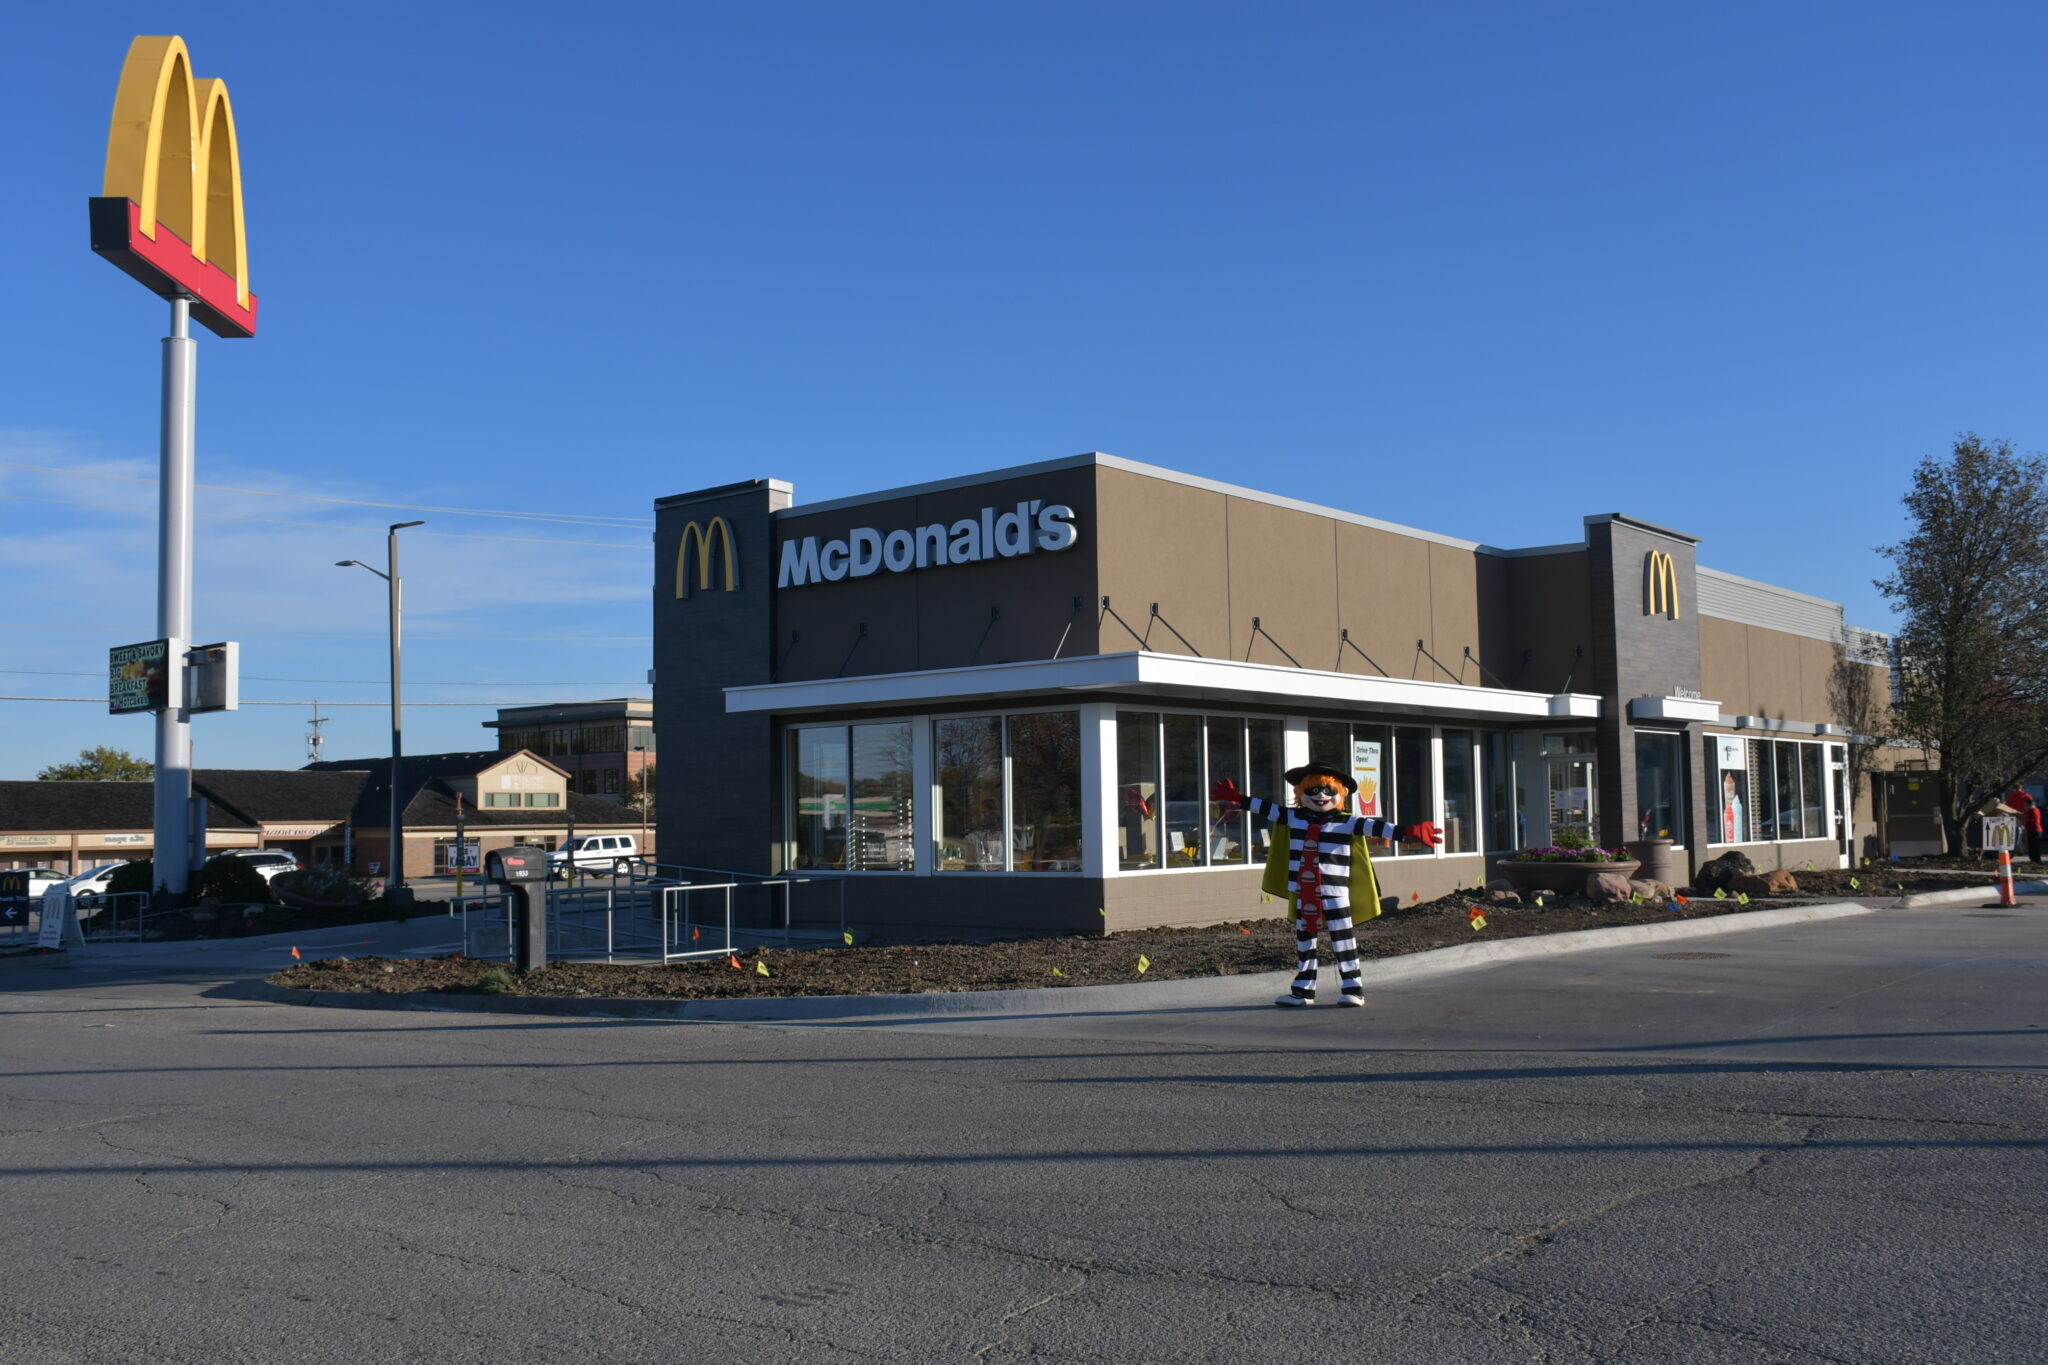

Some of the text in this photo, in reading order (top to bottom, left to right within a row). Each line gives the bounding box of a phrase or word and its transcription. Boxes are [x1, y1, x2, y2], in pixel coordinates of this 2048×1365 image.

[777, 499, 1078, 588] McDonald's
[110, 649, 130, 663] SWEET
[138, 643, 164, 658] SAVORY
[110, 667, 122, 680] BIG
[110, 679, 147, 694] BREAKFAST
[1674, 685, 1701, 699] Welcome
